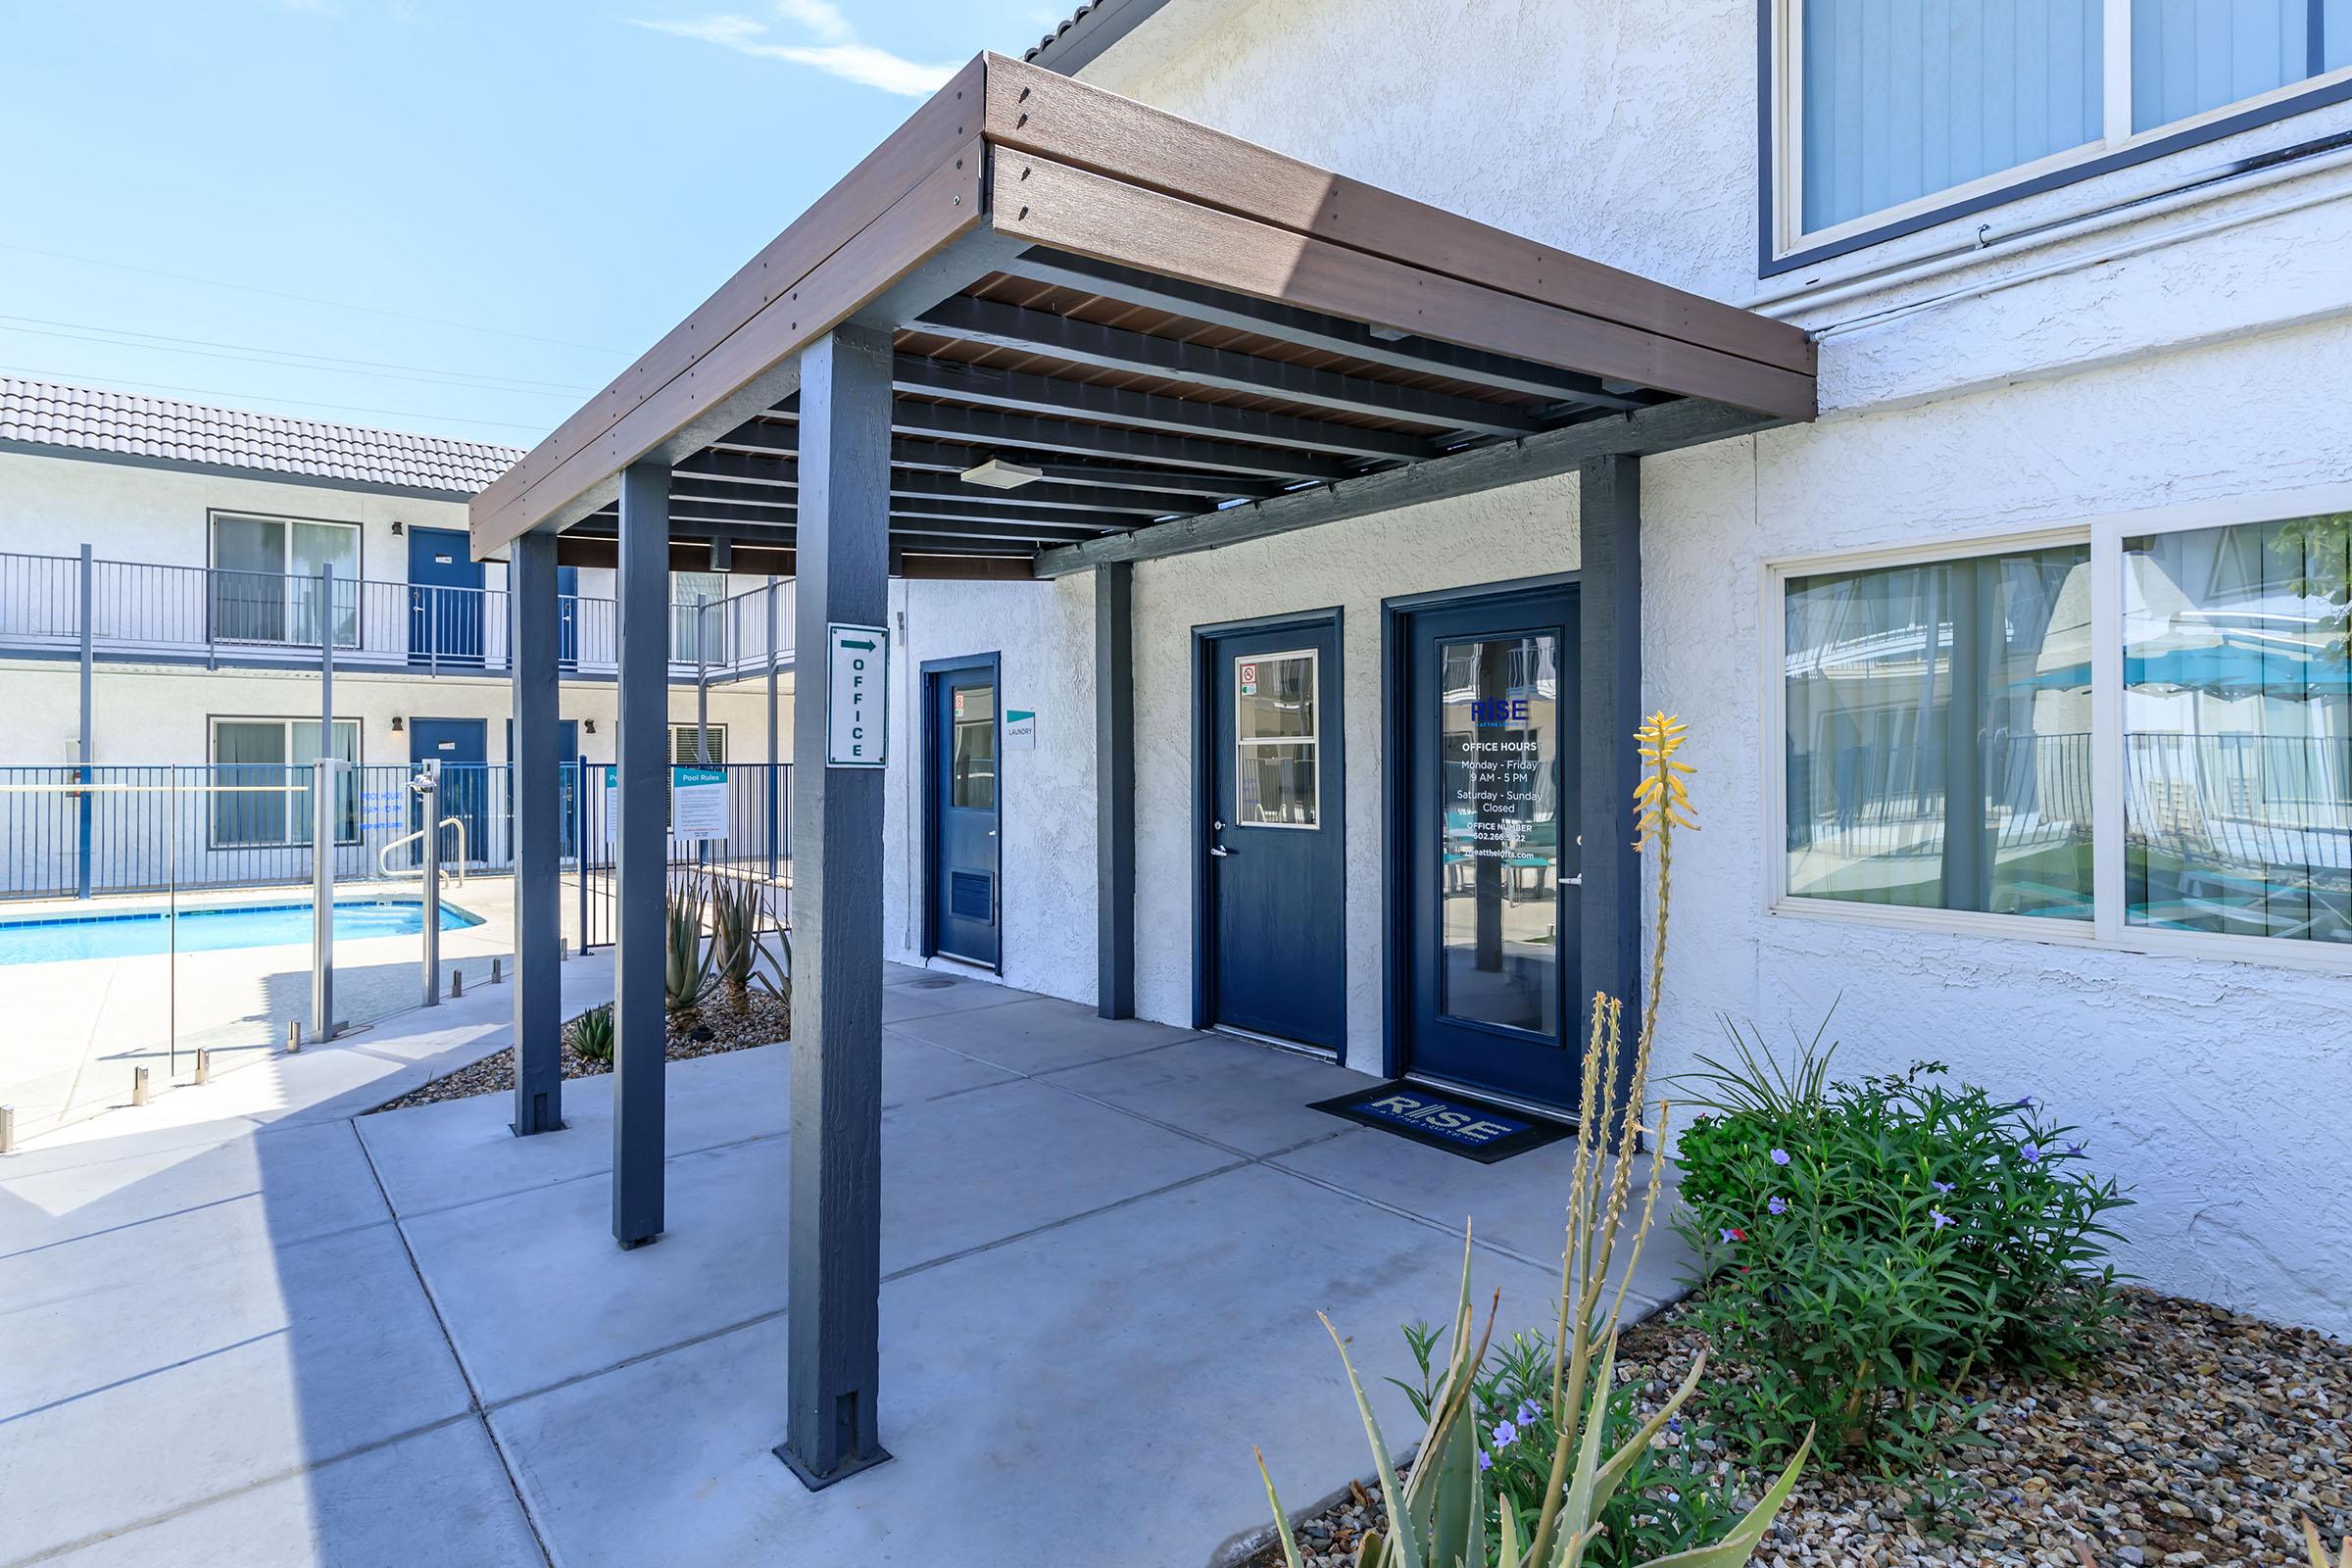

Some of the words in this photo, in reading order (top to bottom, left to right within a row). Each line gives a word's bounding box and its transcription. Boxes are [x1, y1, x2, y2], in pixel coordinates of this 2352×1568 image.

[852, 659, 864, 757] OFFICE
[1471, 696, 1529, 722] RISE
[1462, 742, 1498, 752] OFFICE
[1500, 742, 1537, 752] HOURS
[1461, 760, 1498, 771] Monday
[1506, 760, 1538, 771] Friday
[1470, 773, 1477, 782] 9
[1479, 773, 1494, 782] AM
[1503, 773, 1510, 782] 5
[1513, 773, 1528, 782] PM
[1456, 790, 1498, 801] Saturday
[1506, 791, 1543, 802] Sunday
[1483, 804, 1515, 812] Closed
[1466, 822, 1496, 831] OFFICE
[1496, 823, 1533, 833] NUMBER
[1372, 1095, 1513, 1141] RISE
